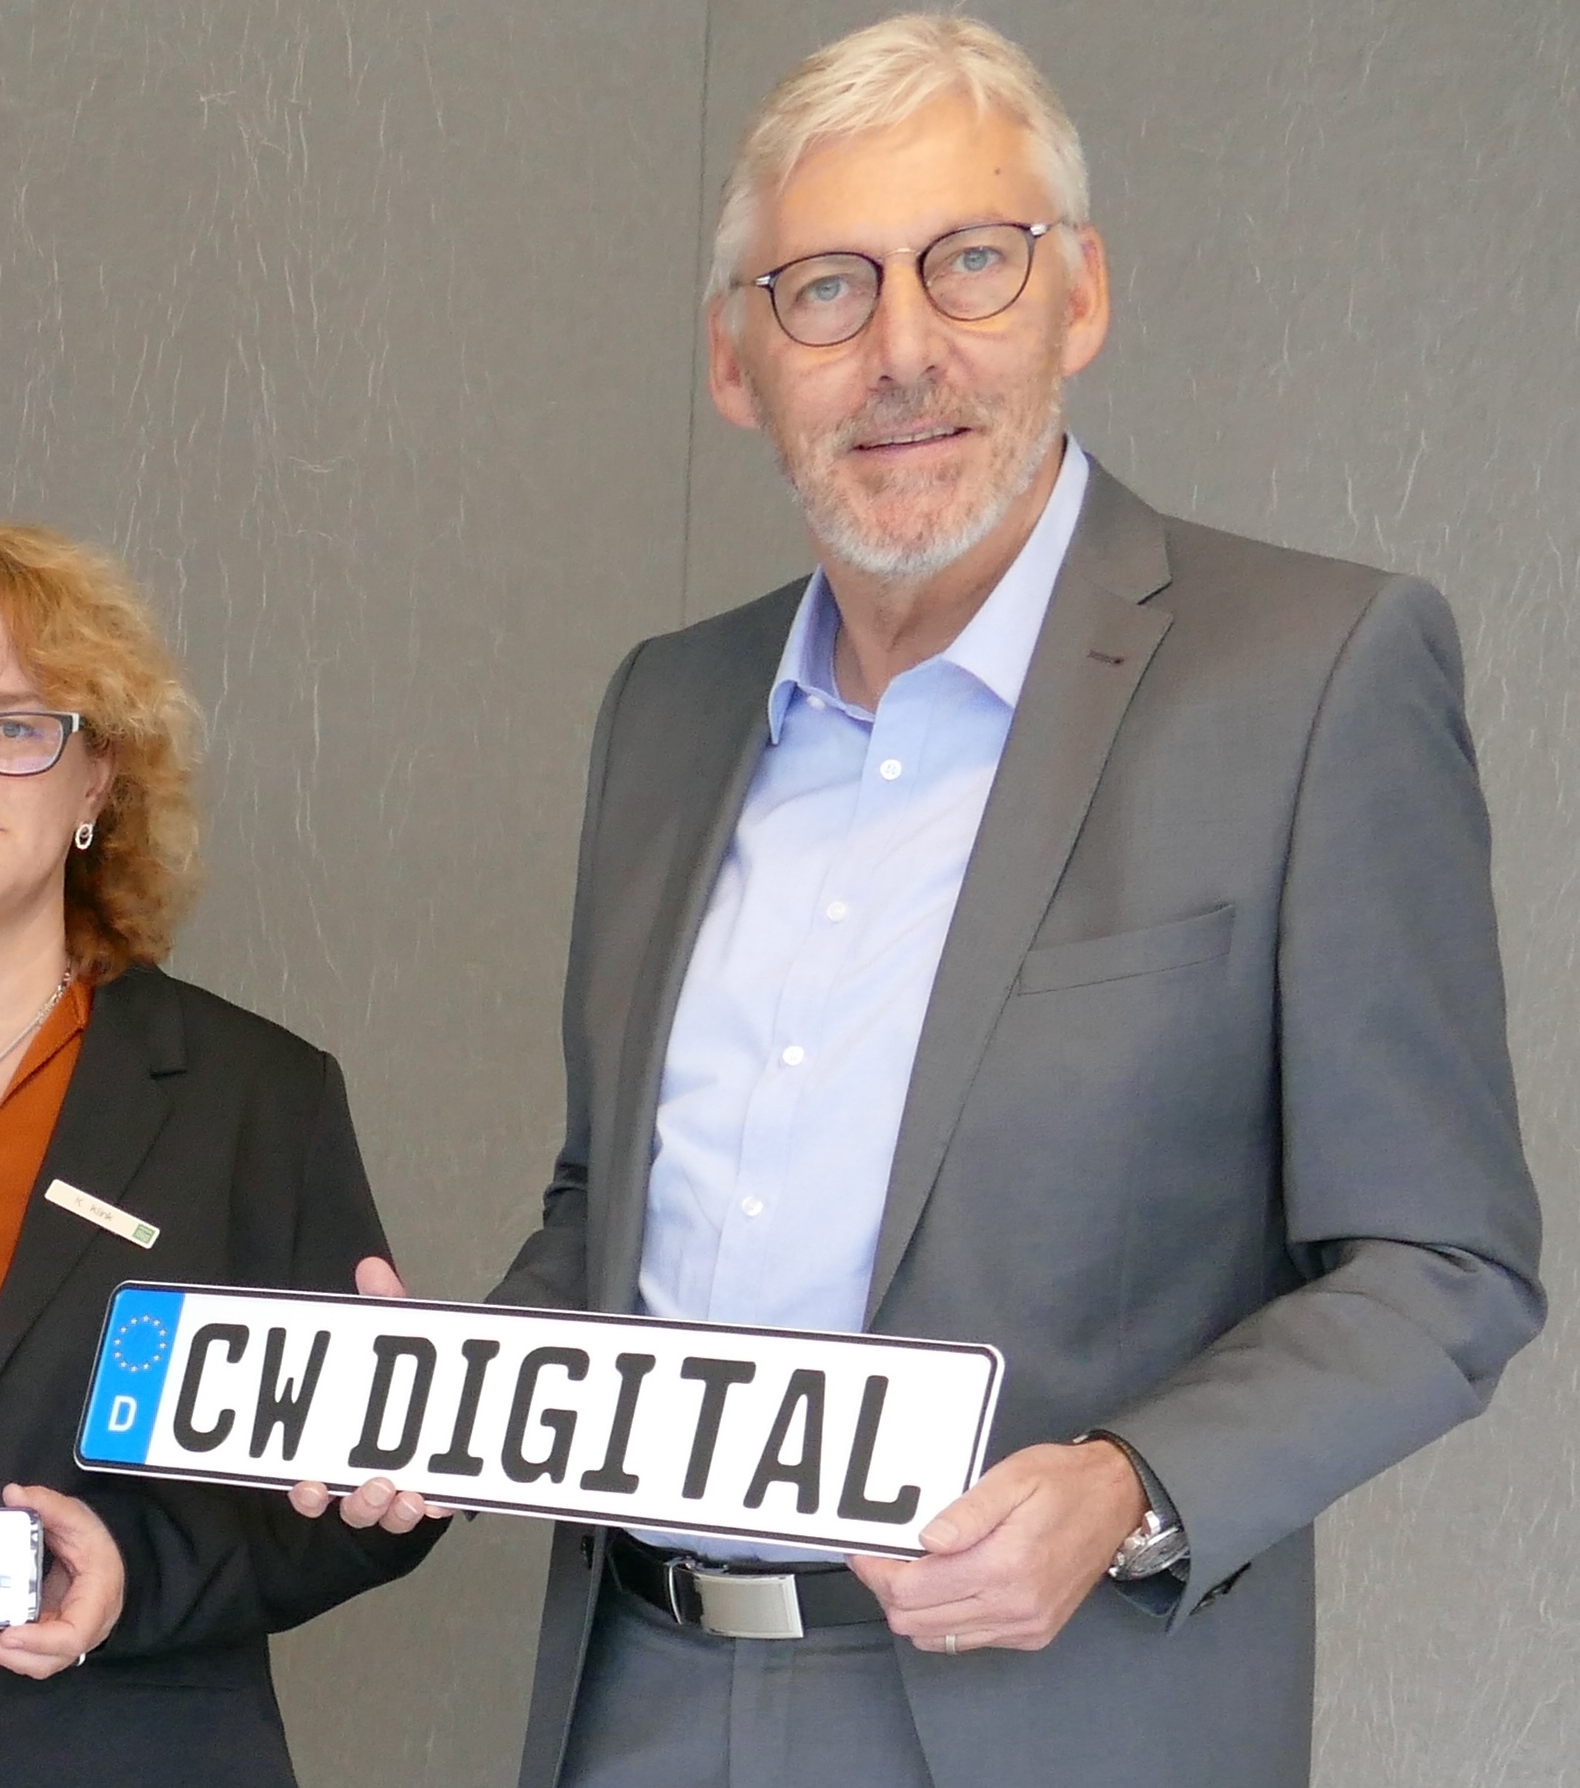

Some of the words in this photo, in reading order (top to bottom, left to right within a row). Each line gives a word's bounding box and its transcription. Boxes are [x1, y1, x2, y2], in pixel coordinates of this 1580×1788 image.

[107, 1395, 137, 1432] D
[171, 1322, 331, 1462] CW
[347, 1334, 922, 1526] DIGITAL
